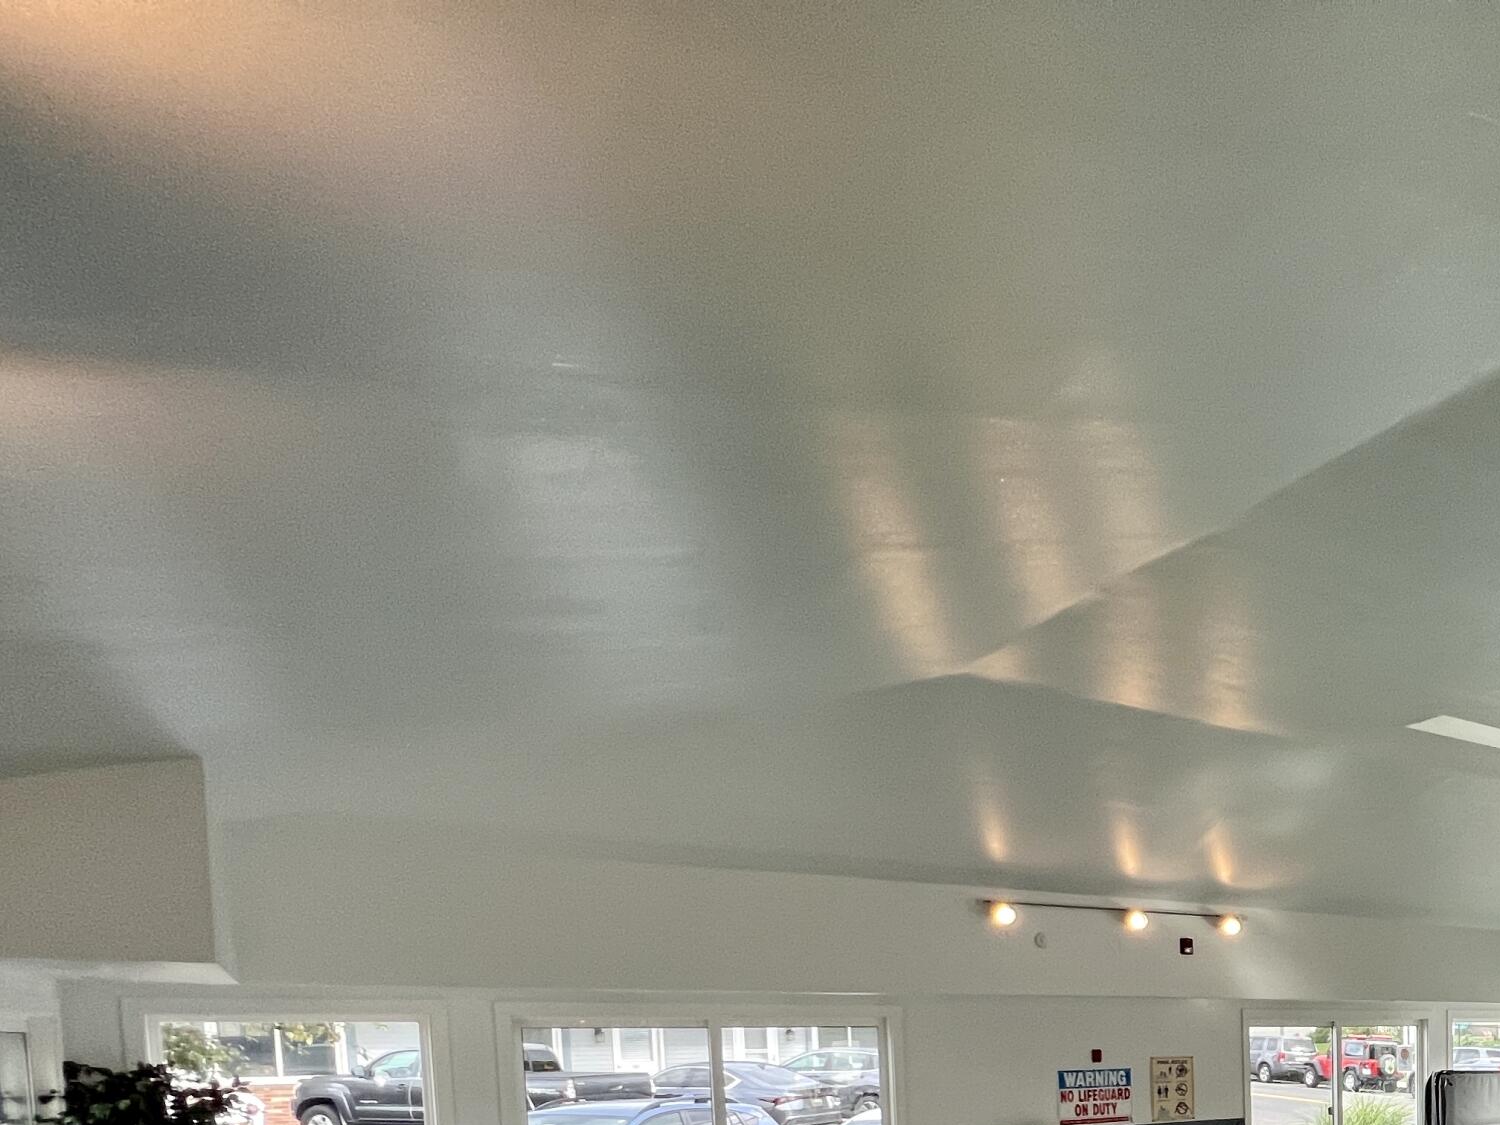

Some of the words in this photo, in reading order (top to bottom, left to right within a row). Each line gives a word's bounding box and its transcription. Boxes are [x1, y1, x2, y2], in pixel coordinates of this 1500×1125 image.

[1064, 1070, 1127, 1087] WARNING
[1060, 1090, 1074, 1103] NO
[1078, 1088, 1131, 1102] LIFEGUARD
[1075, 1103, 1088, 1116] ON
[1092, 1102, 1117, 1115] DUTY
